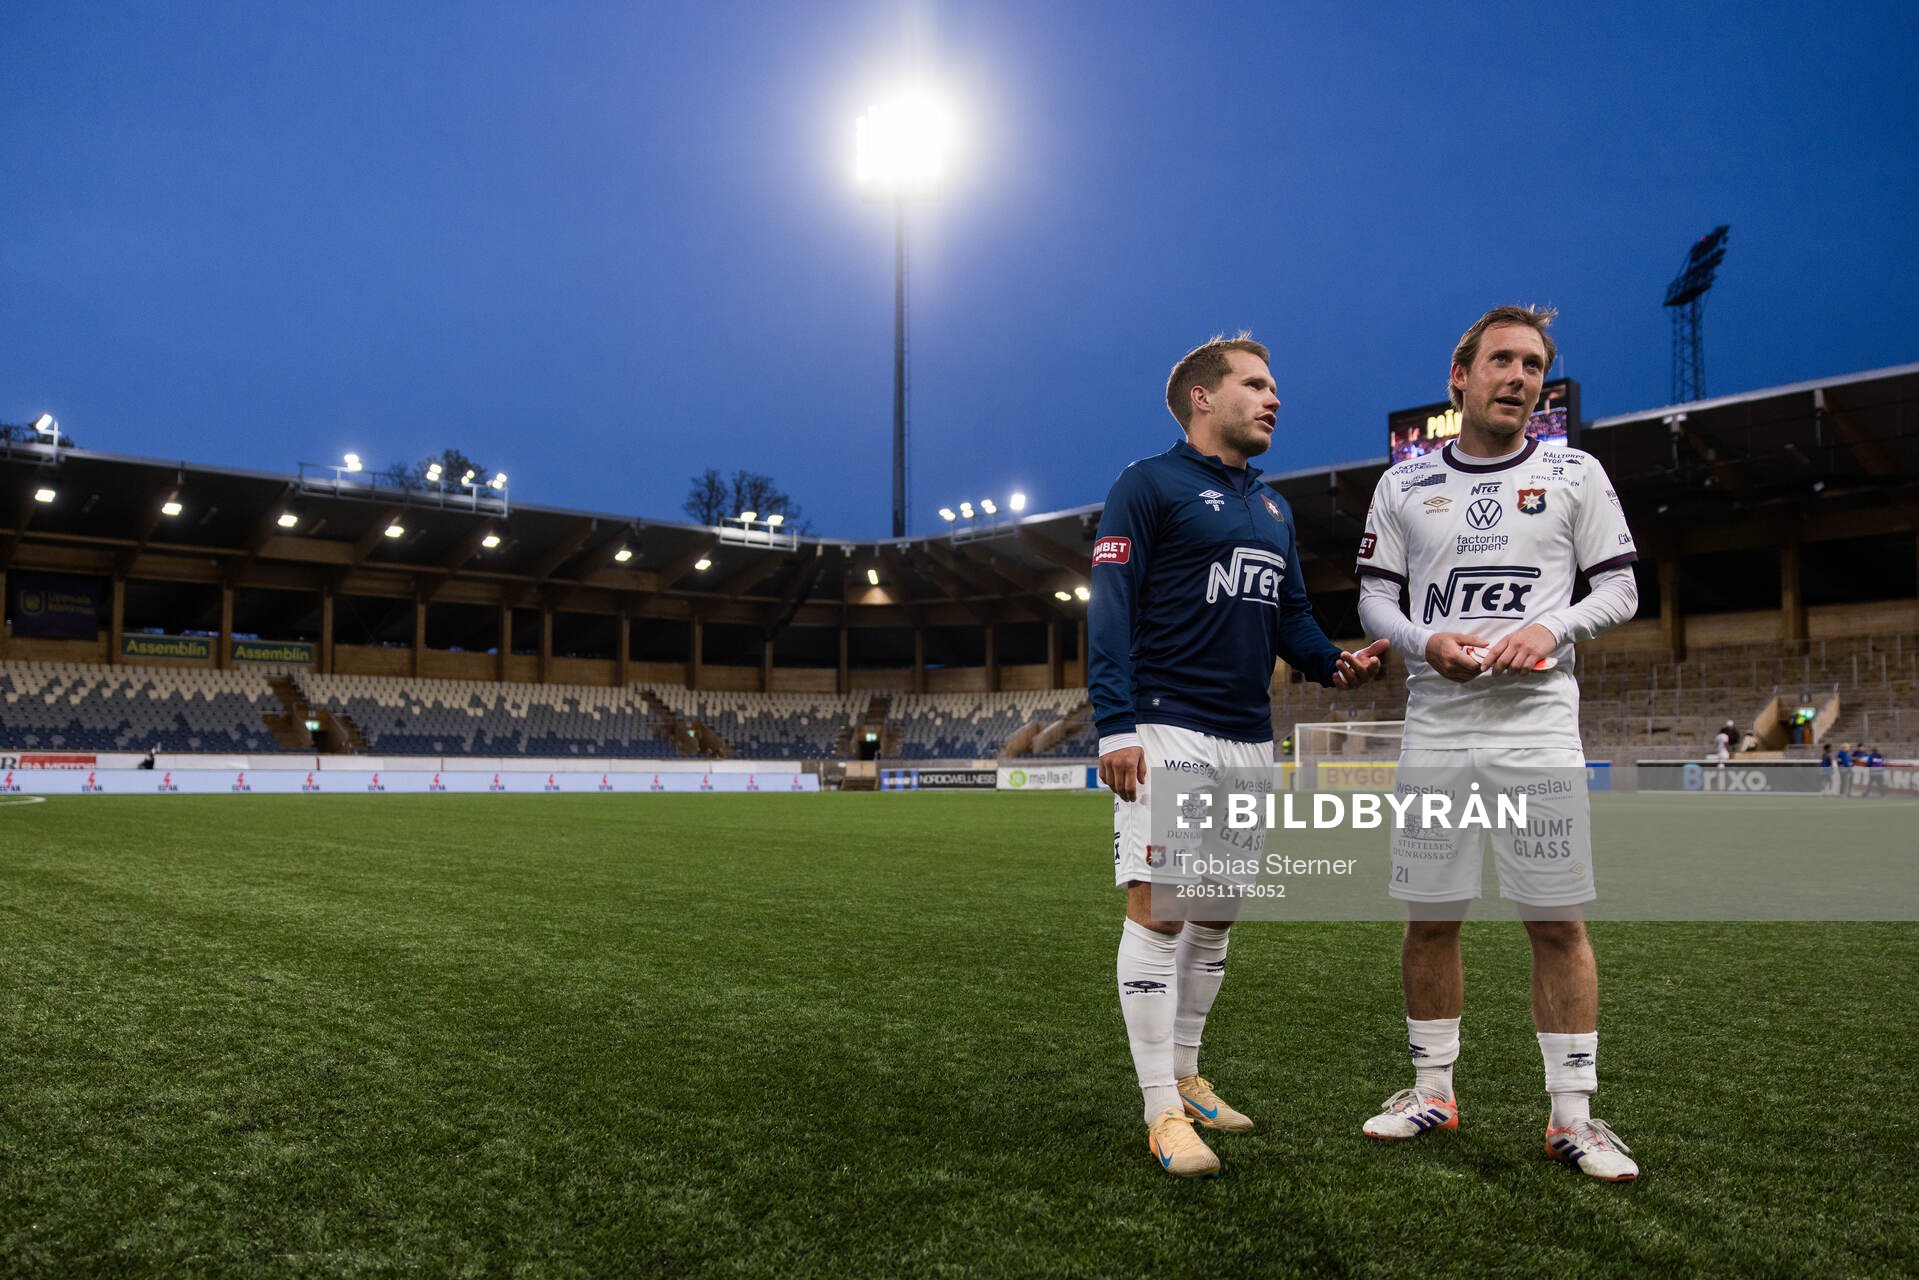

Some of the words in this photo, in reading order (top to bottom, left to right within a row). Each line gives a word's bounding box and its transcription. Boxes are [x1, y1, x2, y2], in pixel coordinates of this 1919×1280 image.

[1471, 482, 1502, 496] NTEX
[1457, 534, 1508, 546] factoring
[1206, 547, 1286, 607] NTEX
[1423, 566, 1541, 624] NTEX
[126, 640, 206, 656] Assemblin
[235, 645, 310, 661] Assemblin
[1500, 779, 1572, 798] wesslau
[1398, 839, 1453, 850] STIFTELSEN
[1514, 839, 1571, 859] GLASS
[1395, 865, 1409, 884] 21
